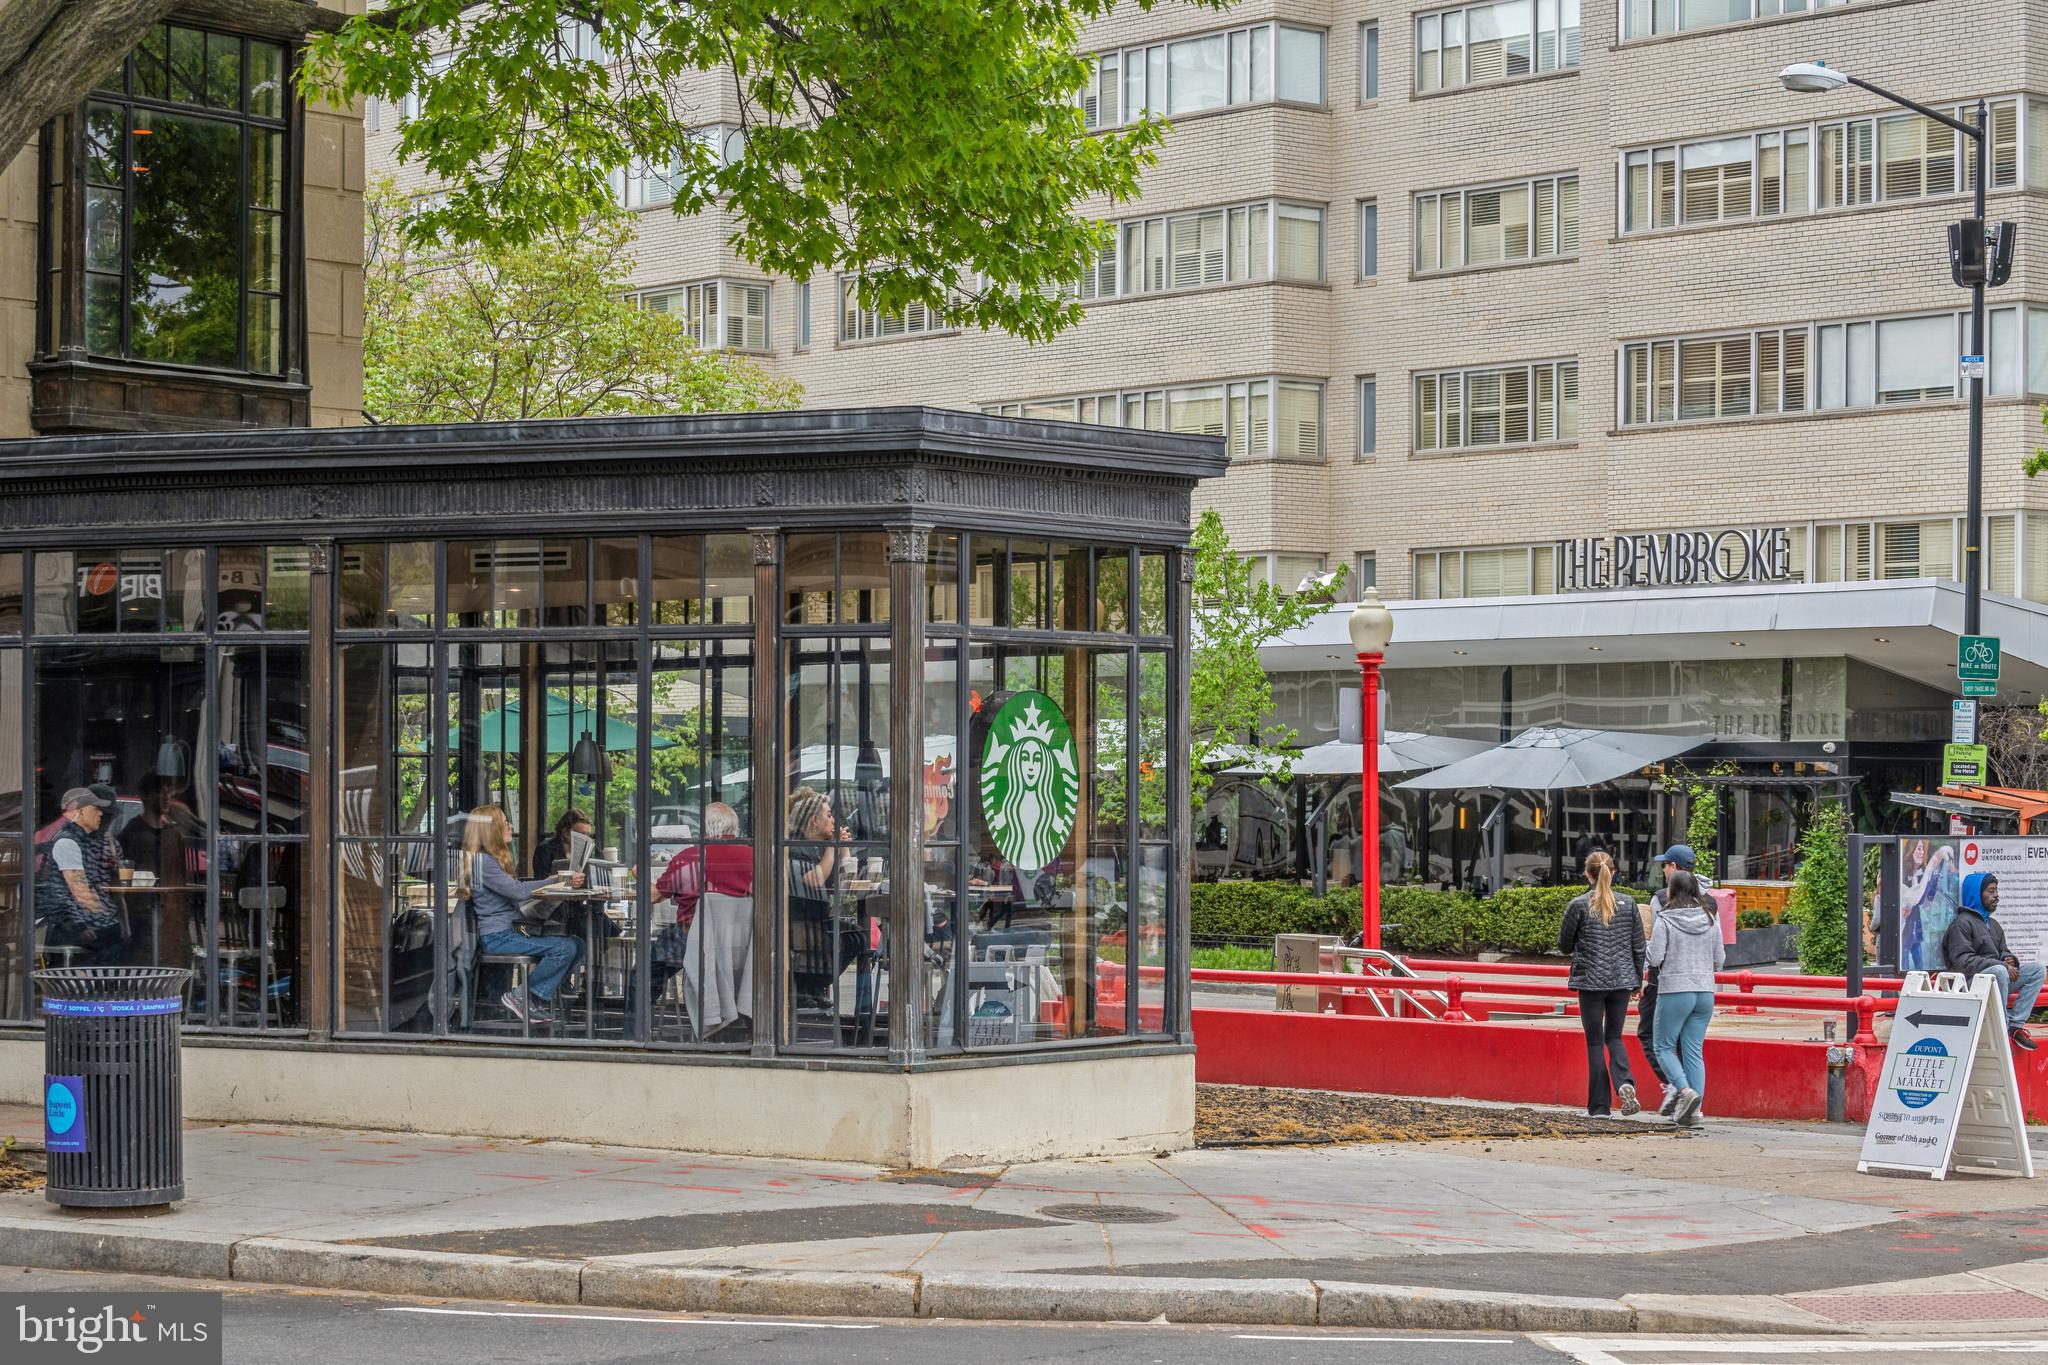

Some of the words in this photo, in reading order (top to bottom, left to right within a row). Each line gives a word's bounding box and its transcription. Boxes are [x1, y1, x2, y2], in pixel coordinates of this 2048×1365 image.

[1555, 538, 1608, 588] THE
[1615, 528, 1791, 587] PEMBROKE
[1906, 1058, 1945, 1069] LITTLE
[1910, 1068, 1935, 1078] FLEA
[1897, 1077, 1945, 1088] MARKET
